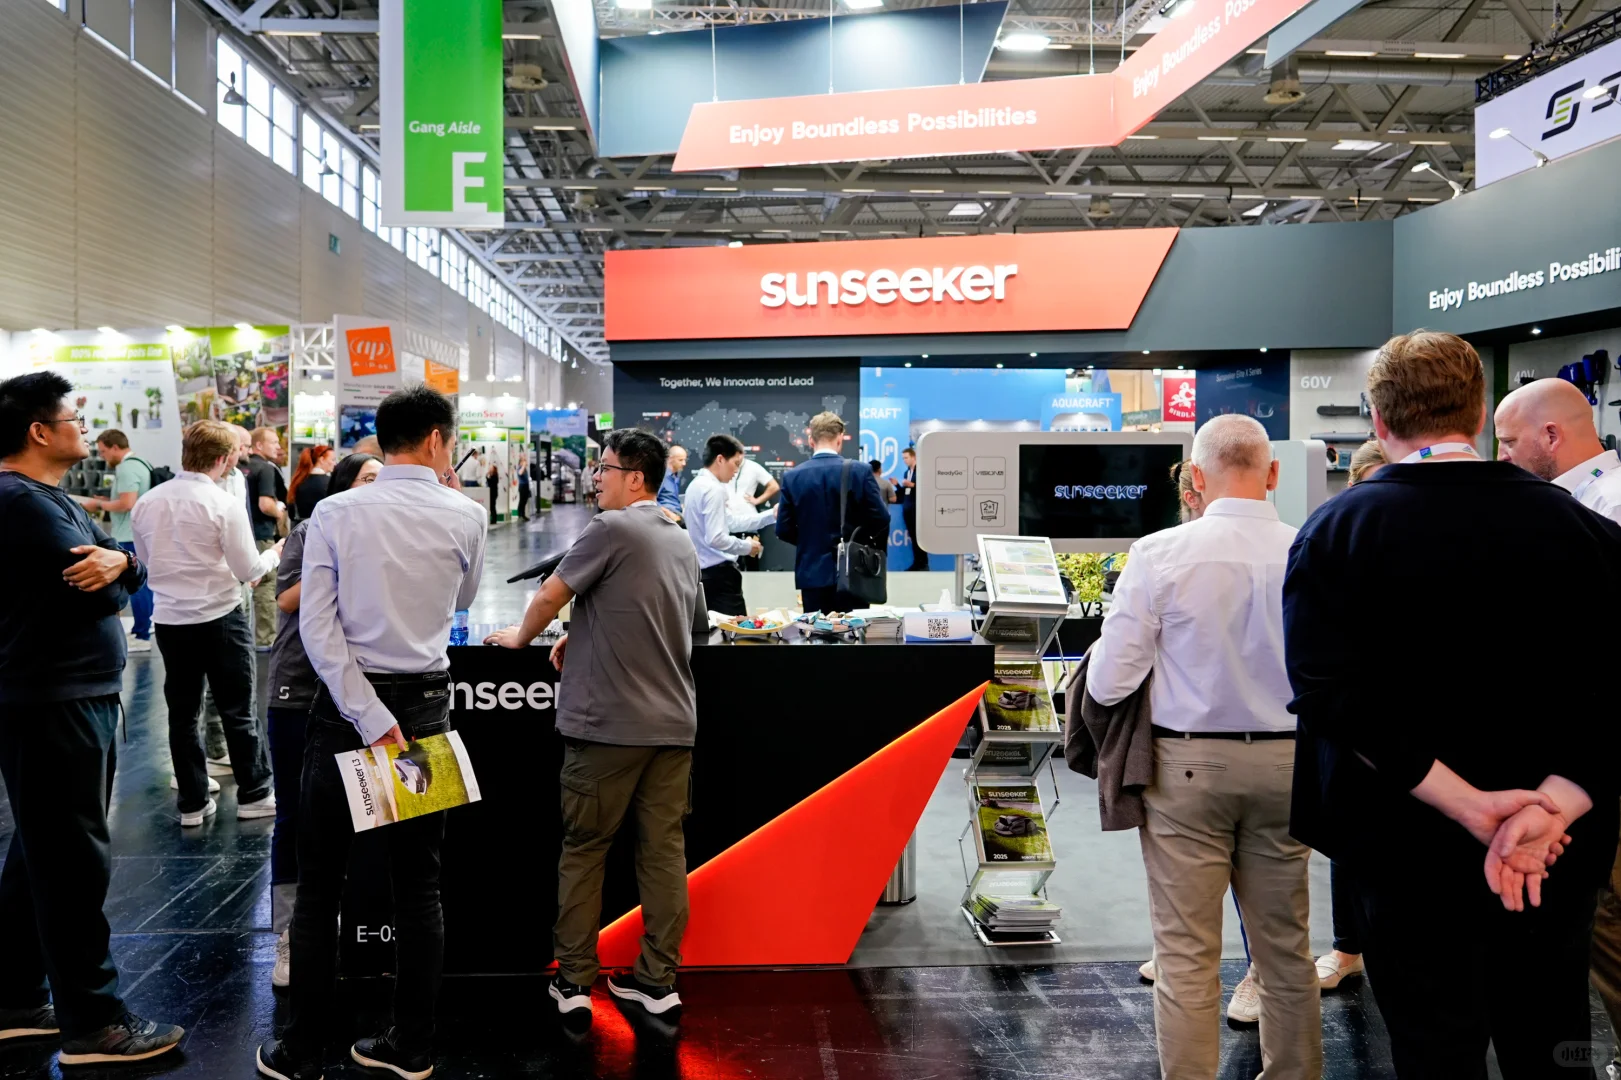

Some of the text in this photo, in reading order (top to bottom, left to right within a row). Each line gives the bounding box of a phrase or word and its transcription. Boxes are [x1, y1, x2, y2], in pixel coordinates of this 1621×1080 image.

[1133, 62, 1160, 99] Enjoy
[1162, 15, 1221, 75] Boundless
[408, 120, 482, 137] Gang Aisle
[729, 107, 1037, 146] Enjoy Boundless Possibilities
[452, 152, 487, 211] E
[760, 264, 1018, 308] sunseeker
[1429, 246, 1621, 312] Enjoy Boundless Possibili
[659, 376, 814, 389] Together, We Innovate and Lead
[1300, 376, 1332, 389] 60V
[1052, 398, 1110, 408] AQUACRAFT
[1054, 484, 1147, 499] sunseeker
[983, 503, 995, 511] 2+1
[1080, 602, 1103, 618] V3
[351, 758, 374, 816] sunseeker L3
[988, 790, 1028, 798] sunseeker
